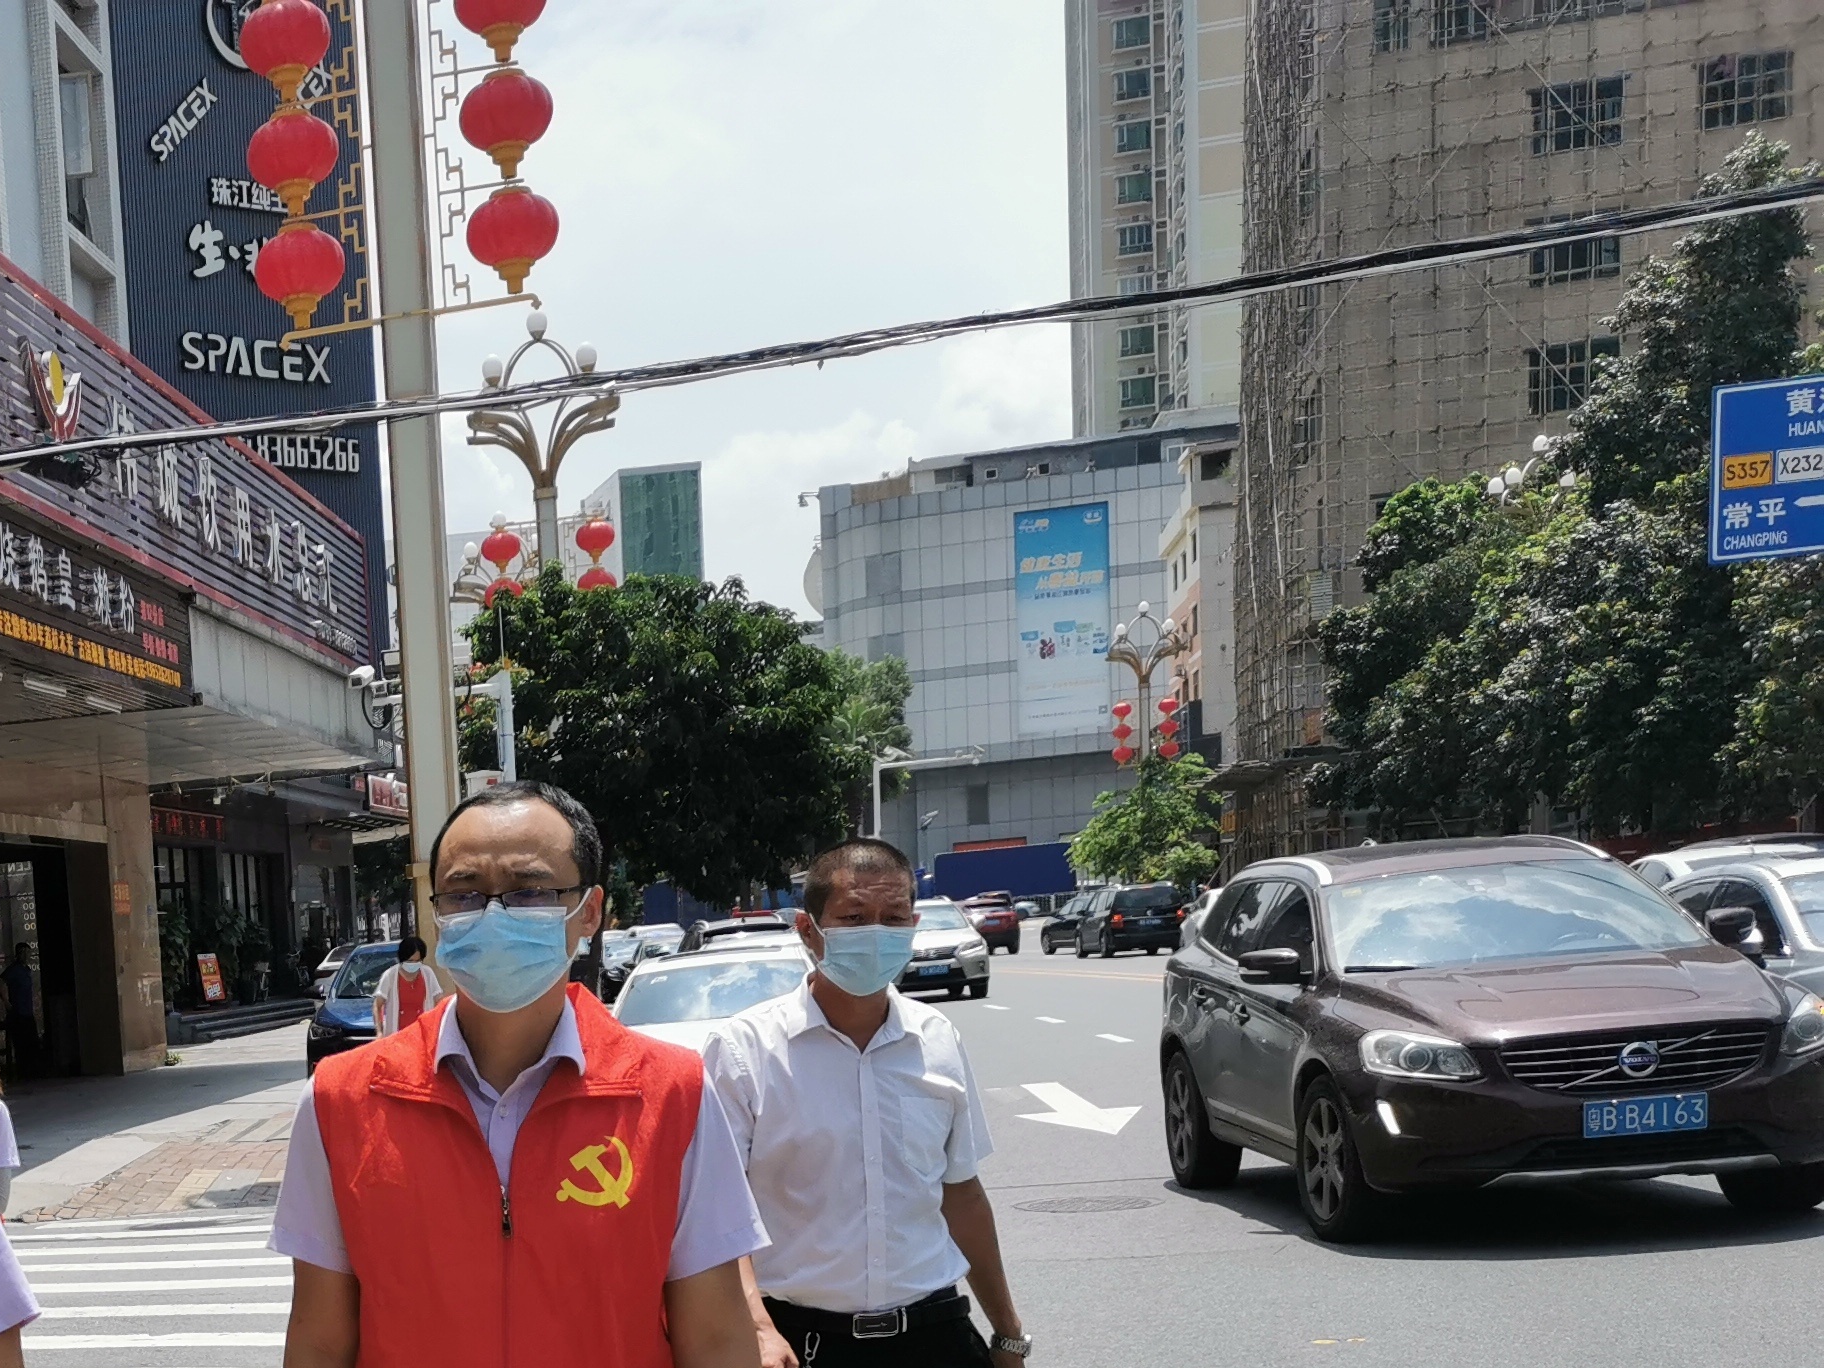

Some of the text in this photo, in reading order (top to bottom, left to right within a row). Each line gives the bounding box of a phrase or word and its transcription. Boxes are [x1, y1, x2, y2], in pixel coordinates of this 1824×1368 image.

[150, 77, 218, 162] SPACEX
[182, 331, 332, 384] SPACEX
[1726, 453, 1823, 481] S357 X232
[1723, 497, 1786, 530] 常平
[1723, 530, 1788, 550] CHANGPING
[1622, 1055, 1657, 1064] VOLVO
